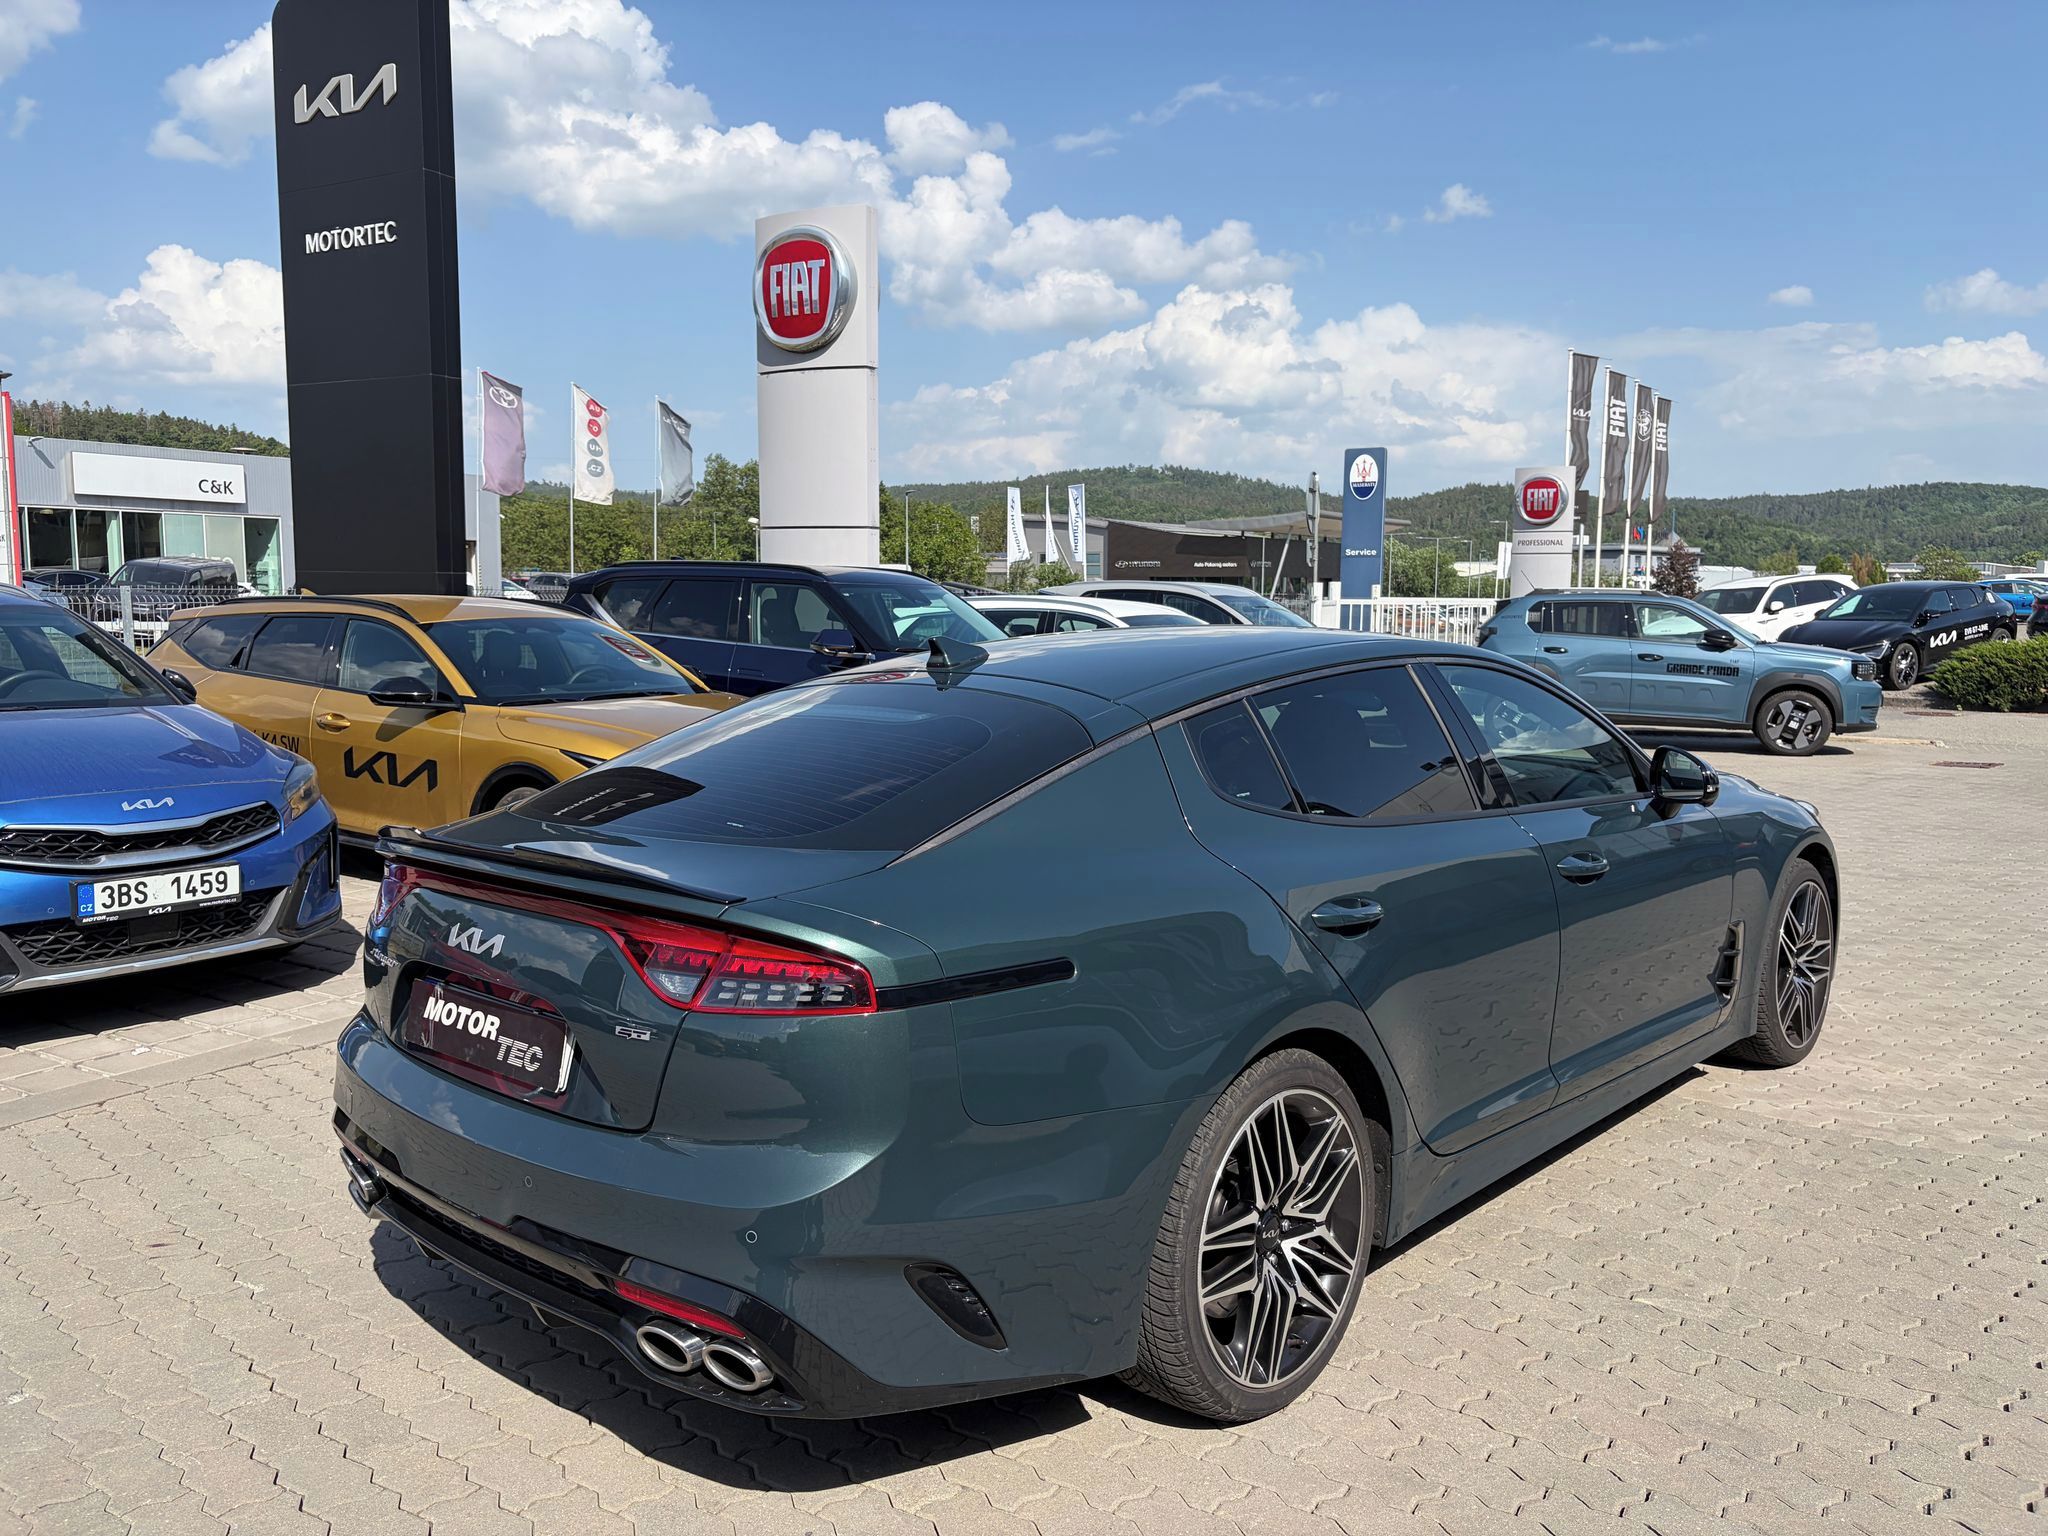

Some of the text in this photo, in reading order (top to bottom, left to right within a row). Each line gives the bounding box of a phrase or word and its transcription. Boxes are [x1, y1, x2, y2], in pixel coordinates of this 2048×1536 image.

[294, 63, 397, 124] KIA
[305, 221, 397, 254] MOTORTEC
[769, 259, 825, 318] FIAT
[1609, 396, 1627, 437] FIAT
[1656, 419, 1668, 451] FIAT
[199, 479, 234, 495] C&K
[1527, 488, 1557, 511] FIAT
[1345, 548, 1377, 556] Service
[1517, 539, 1563, 547] PROFESSIONAL
[1930, 630, 1957, 648] KIA
[1666, 663, 1740, 677] GRANDE PANDA
[344, 746, 438, 793] KIA
[121, 797, 175, 811] KIA
[101, 870, 229, 910] 3BS 1459
[80, 904, 93, 912] CZ
[148, 906, 172, 915] KIA
[82, 915, 107, 923] MOTOR
[447, 923, 506, 958] KIA
[423, 997, 543, 1072] MOTOR TEC
[1262, 1229, 1280, 1239] KIA
